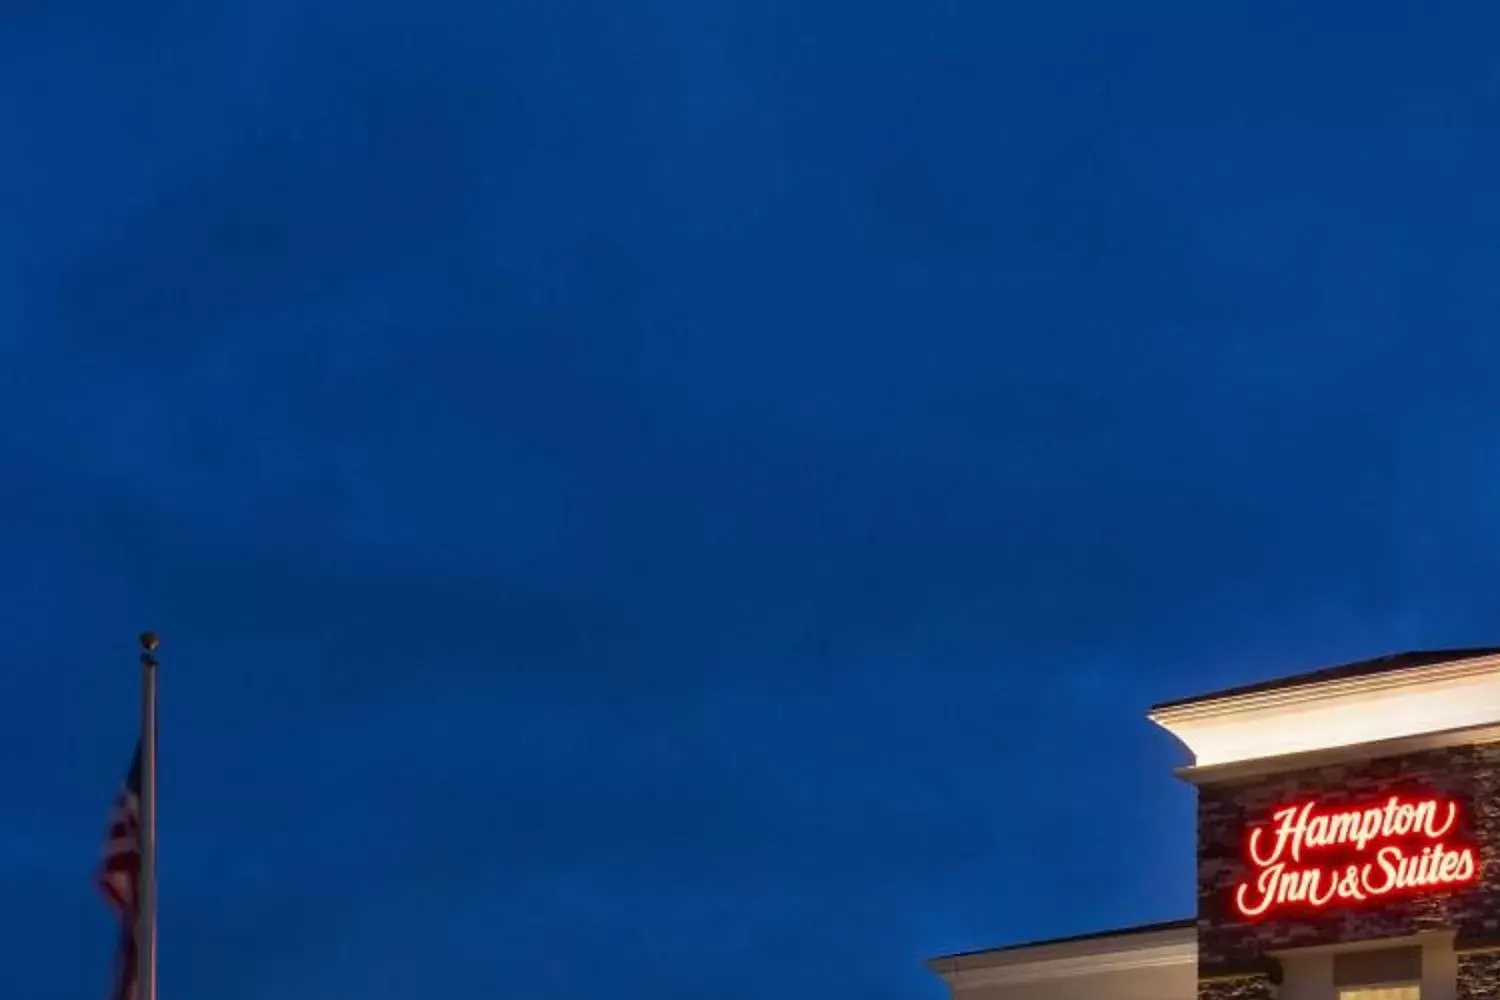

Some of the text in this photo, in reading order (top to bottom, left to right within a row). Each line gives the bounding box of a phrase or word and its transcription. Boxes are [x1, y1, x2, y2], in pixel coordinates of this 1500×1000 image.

[1250, 796, 1456, 867] Hampton
[1236, 843, 1475, 916] Inn & Suites
